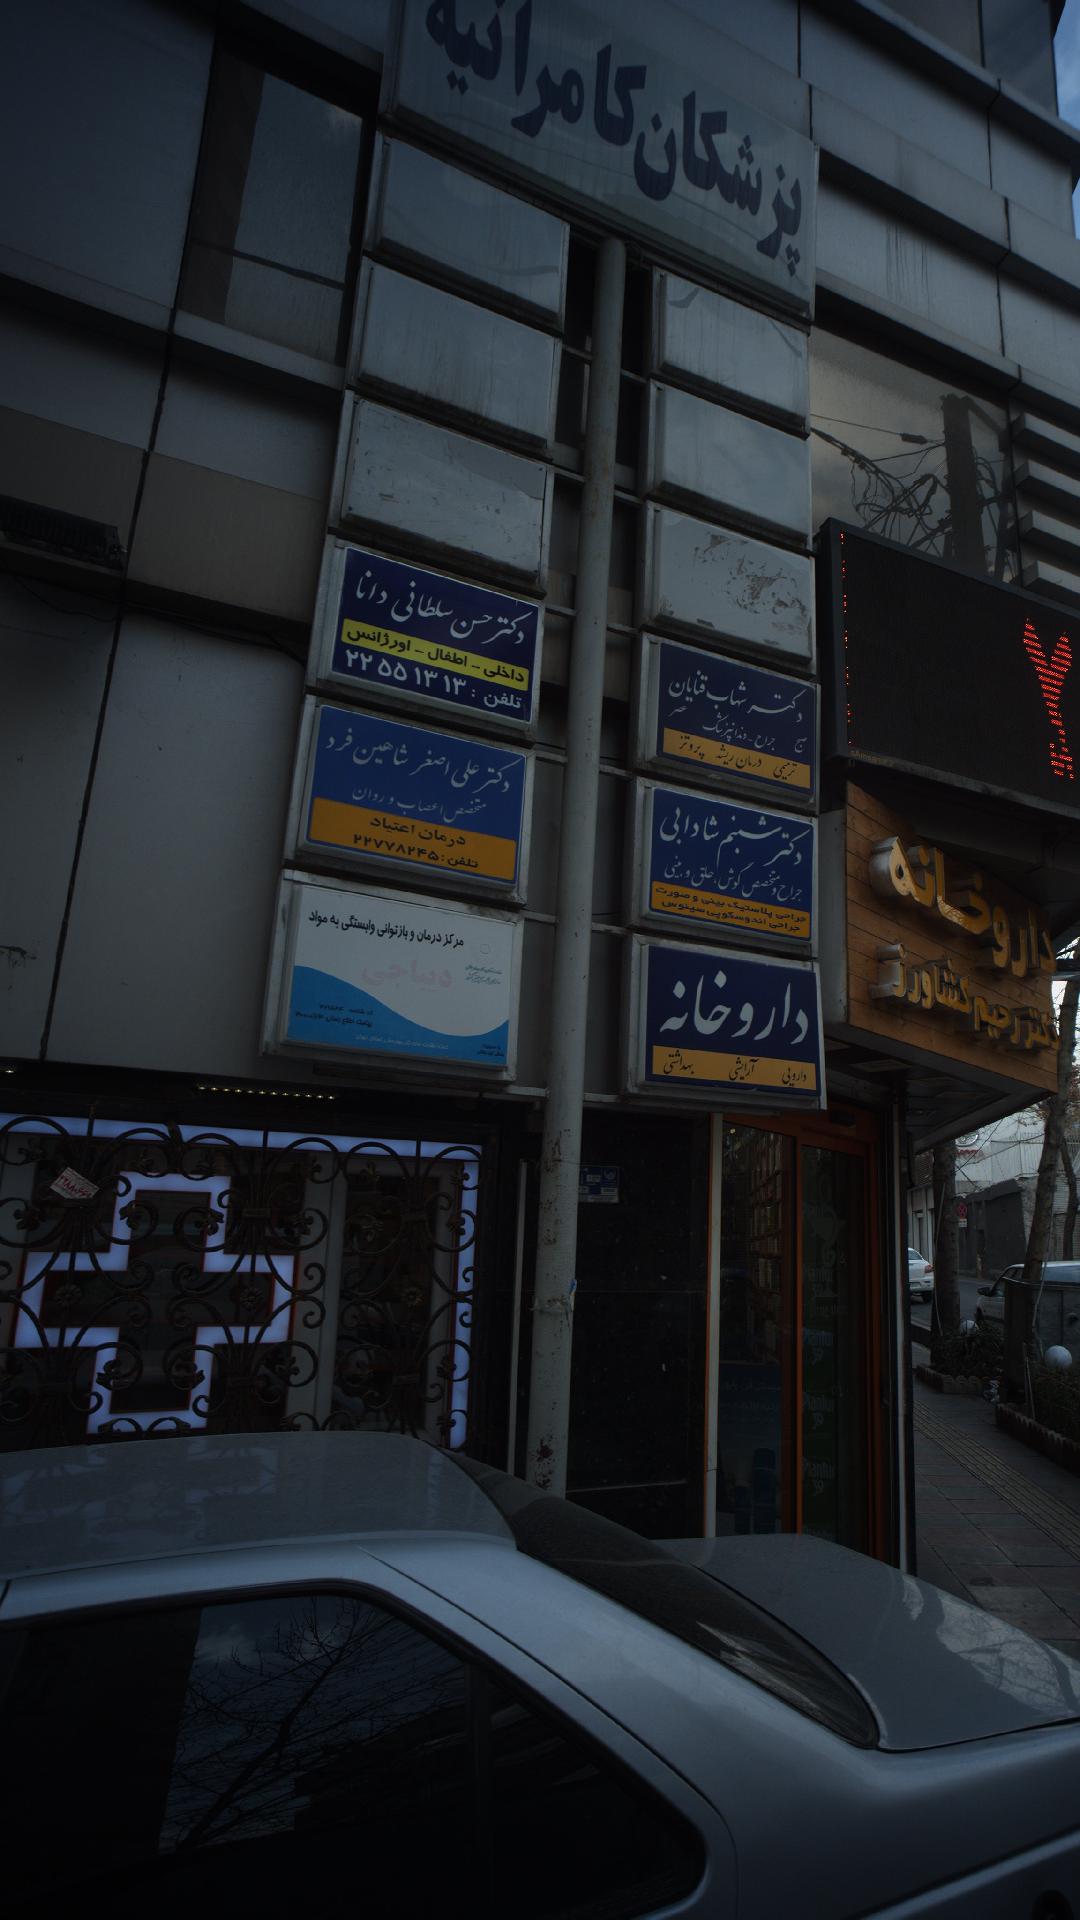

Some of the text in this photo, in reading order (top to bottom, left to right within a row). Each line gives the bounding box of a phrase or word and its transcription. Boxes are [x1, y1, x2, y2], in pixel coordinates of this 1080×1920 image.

[425, 0, 803, 278] پزشکان کامرانیه
[355, 568, 534, 646] دکتر حسن سلطانی دانا
[346, 626, 411, 652] اورژانس
[427, 647, 468, 667] اطفال
[483, 664, 526, 684] داخلی
[705, 680, 747, 710] شهاب
[746, 688, 807, 723] دکتر
[325, 728, 526, 793] دکتر علی اصغر شاهین فرد
[679, 735, 705, 760] پروتز
[735, 756, 762, 769] درمان
[352, 787, 488, 823] متخصص اعصاب و روان
[370, 817, 466, 847] درمان اعتیاد
[659, 806, 810, 870] دکتر شبنم شادابی
[664, 855, 685, 879] بینی
[690, 864, 714, 887] حلق
[656, 886, 692, 899] صورت
[742, 870, 780, 898] متخصص
[776, 884, 803, 902] جراح
[701, 896, 725, 907] بینی
[728, 901, 773, 918] پلاستیک
[882, 836, 1058, 978] داروخانه
[309, 909, 464, 949] مرکز درمان و بازتوانی وابستگی به مواد
[662, 900, 801, 932] جراحی اندوسکوپی سینوس
[891, 942, 971, 1015] کشاورز
[659, 969, 809, 1045] داروخانه
[663, 1049, 694, 1074] بهداشتی
[728, 1056, 760, 1081] آرایشی
